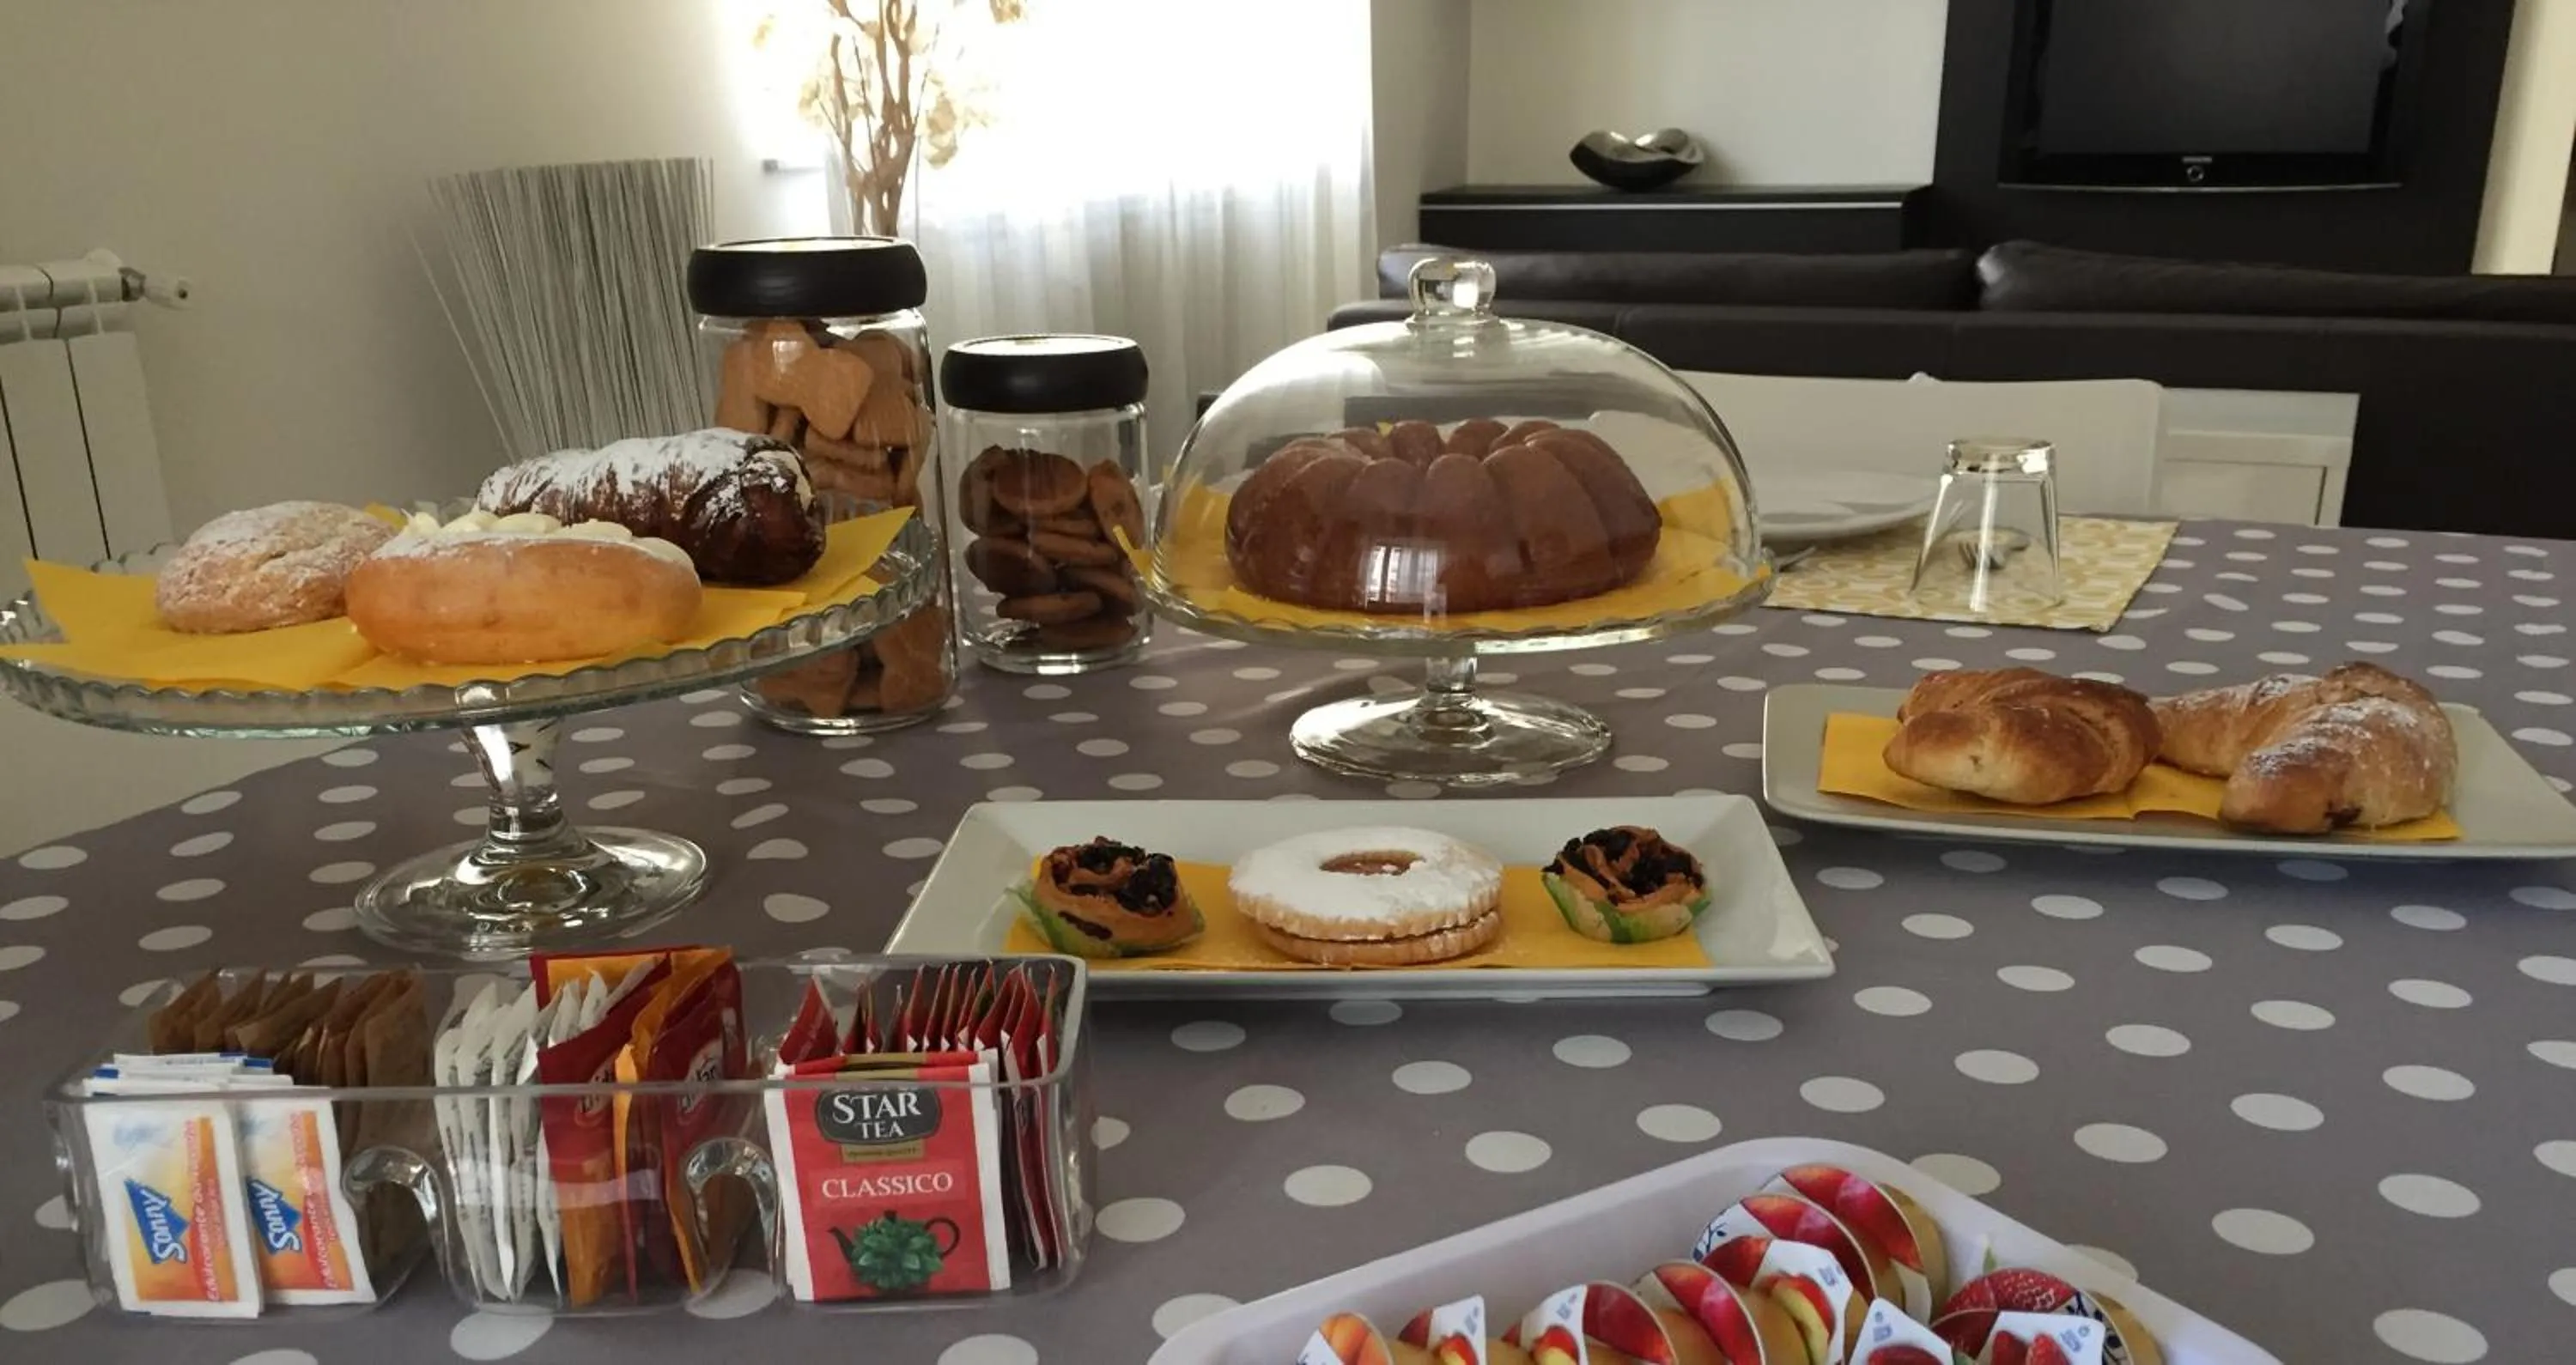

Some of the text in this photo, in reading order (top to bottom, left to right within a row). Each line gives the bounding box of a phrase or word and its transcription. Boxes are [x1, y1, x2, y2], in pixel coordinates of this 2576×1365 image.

[832, 1091, 921, 1124] STAR
[856, 1120, 904, 1139] TEA
[822, 1172, 953, 1198] CLASSICO
[139, 1187, 188, 1264] Sonny
[252, 1181, 302, 1253] Sonny
